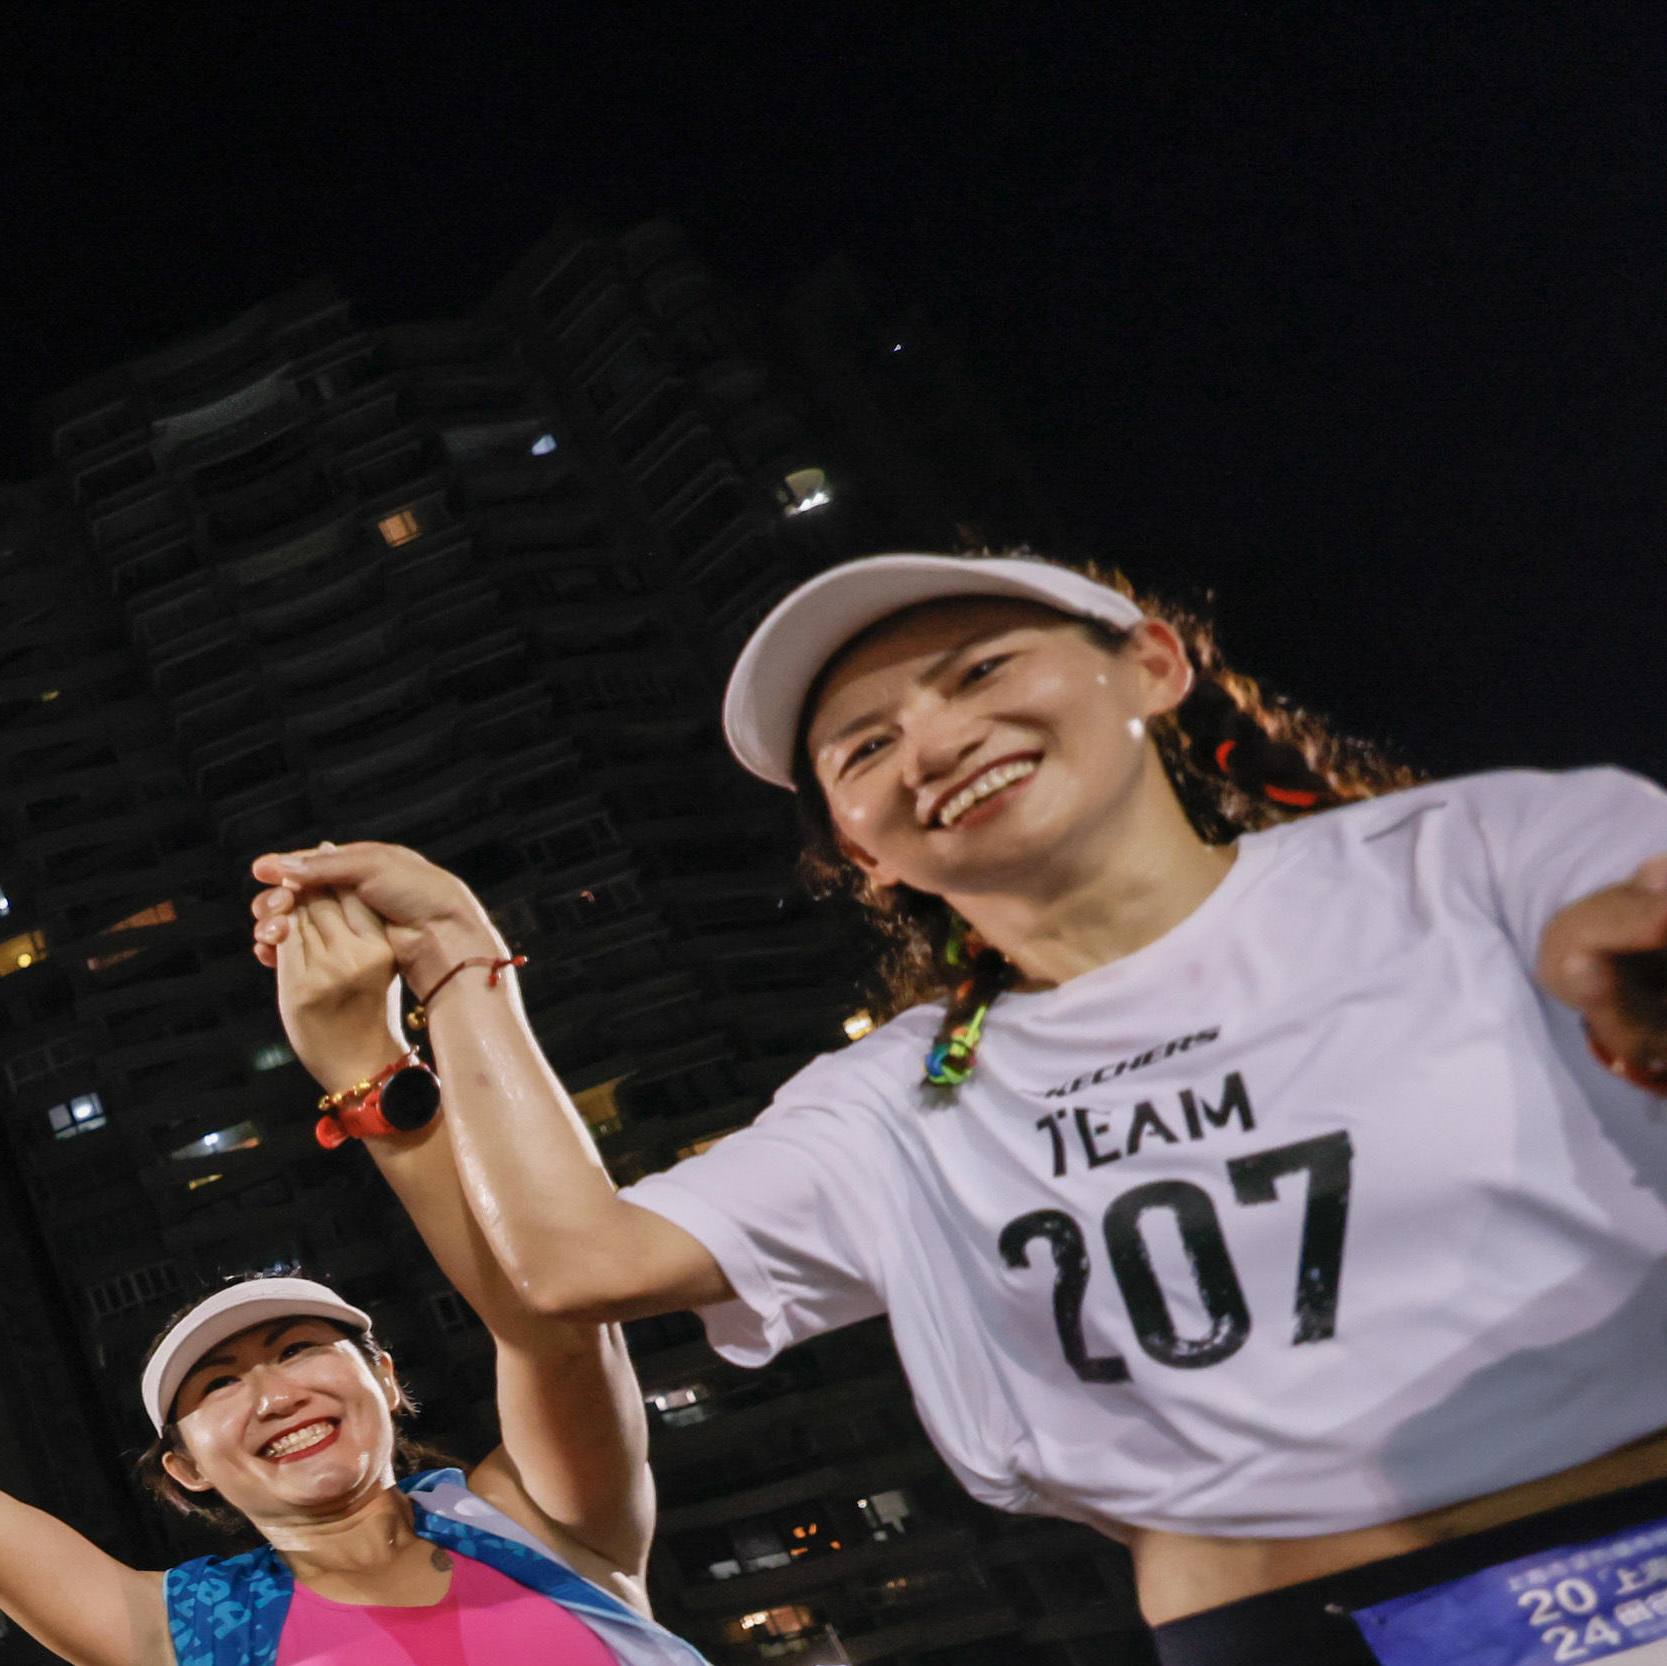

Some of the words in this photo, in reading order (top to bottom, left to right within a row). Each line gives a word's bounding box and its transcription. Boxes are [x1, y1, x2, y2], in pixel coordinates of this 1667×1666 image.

[1043, 1025, 1221, 1099] KECHERS
[1036, 1072, 1256, 1177] TEAM
[998, 1130, 1354, 1384] 207
[1518, 1578, 1598, 1626] 20
[1541, 1616, 1621, 1663] 24
